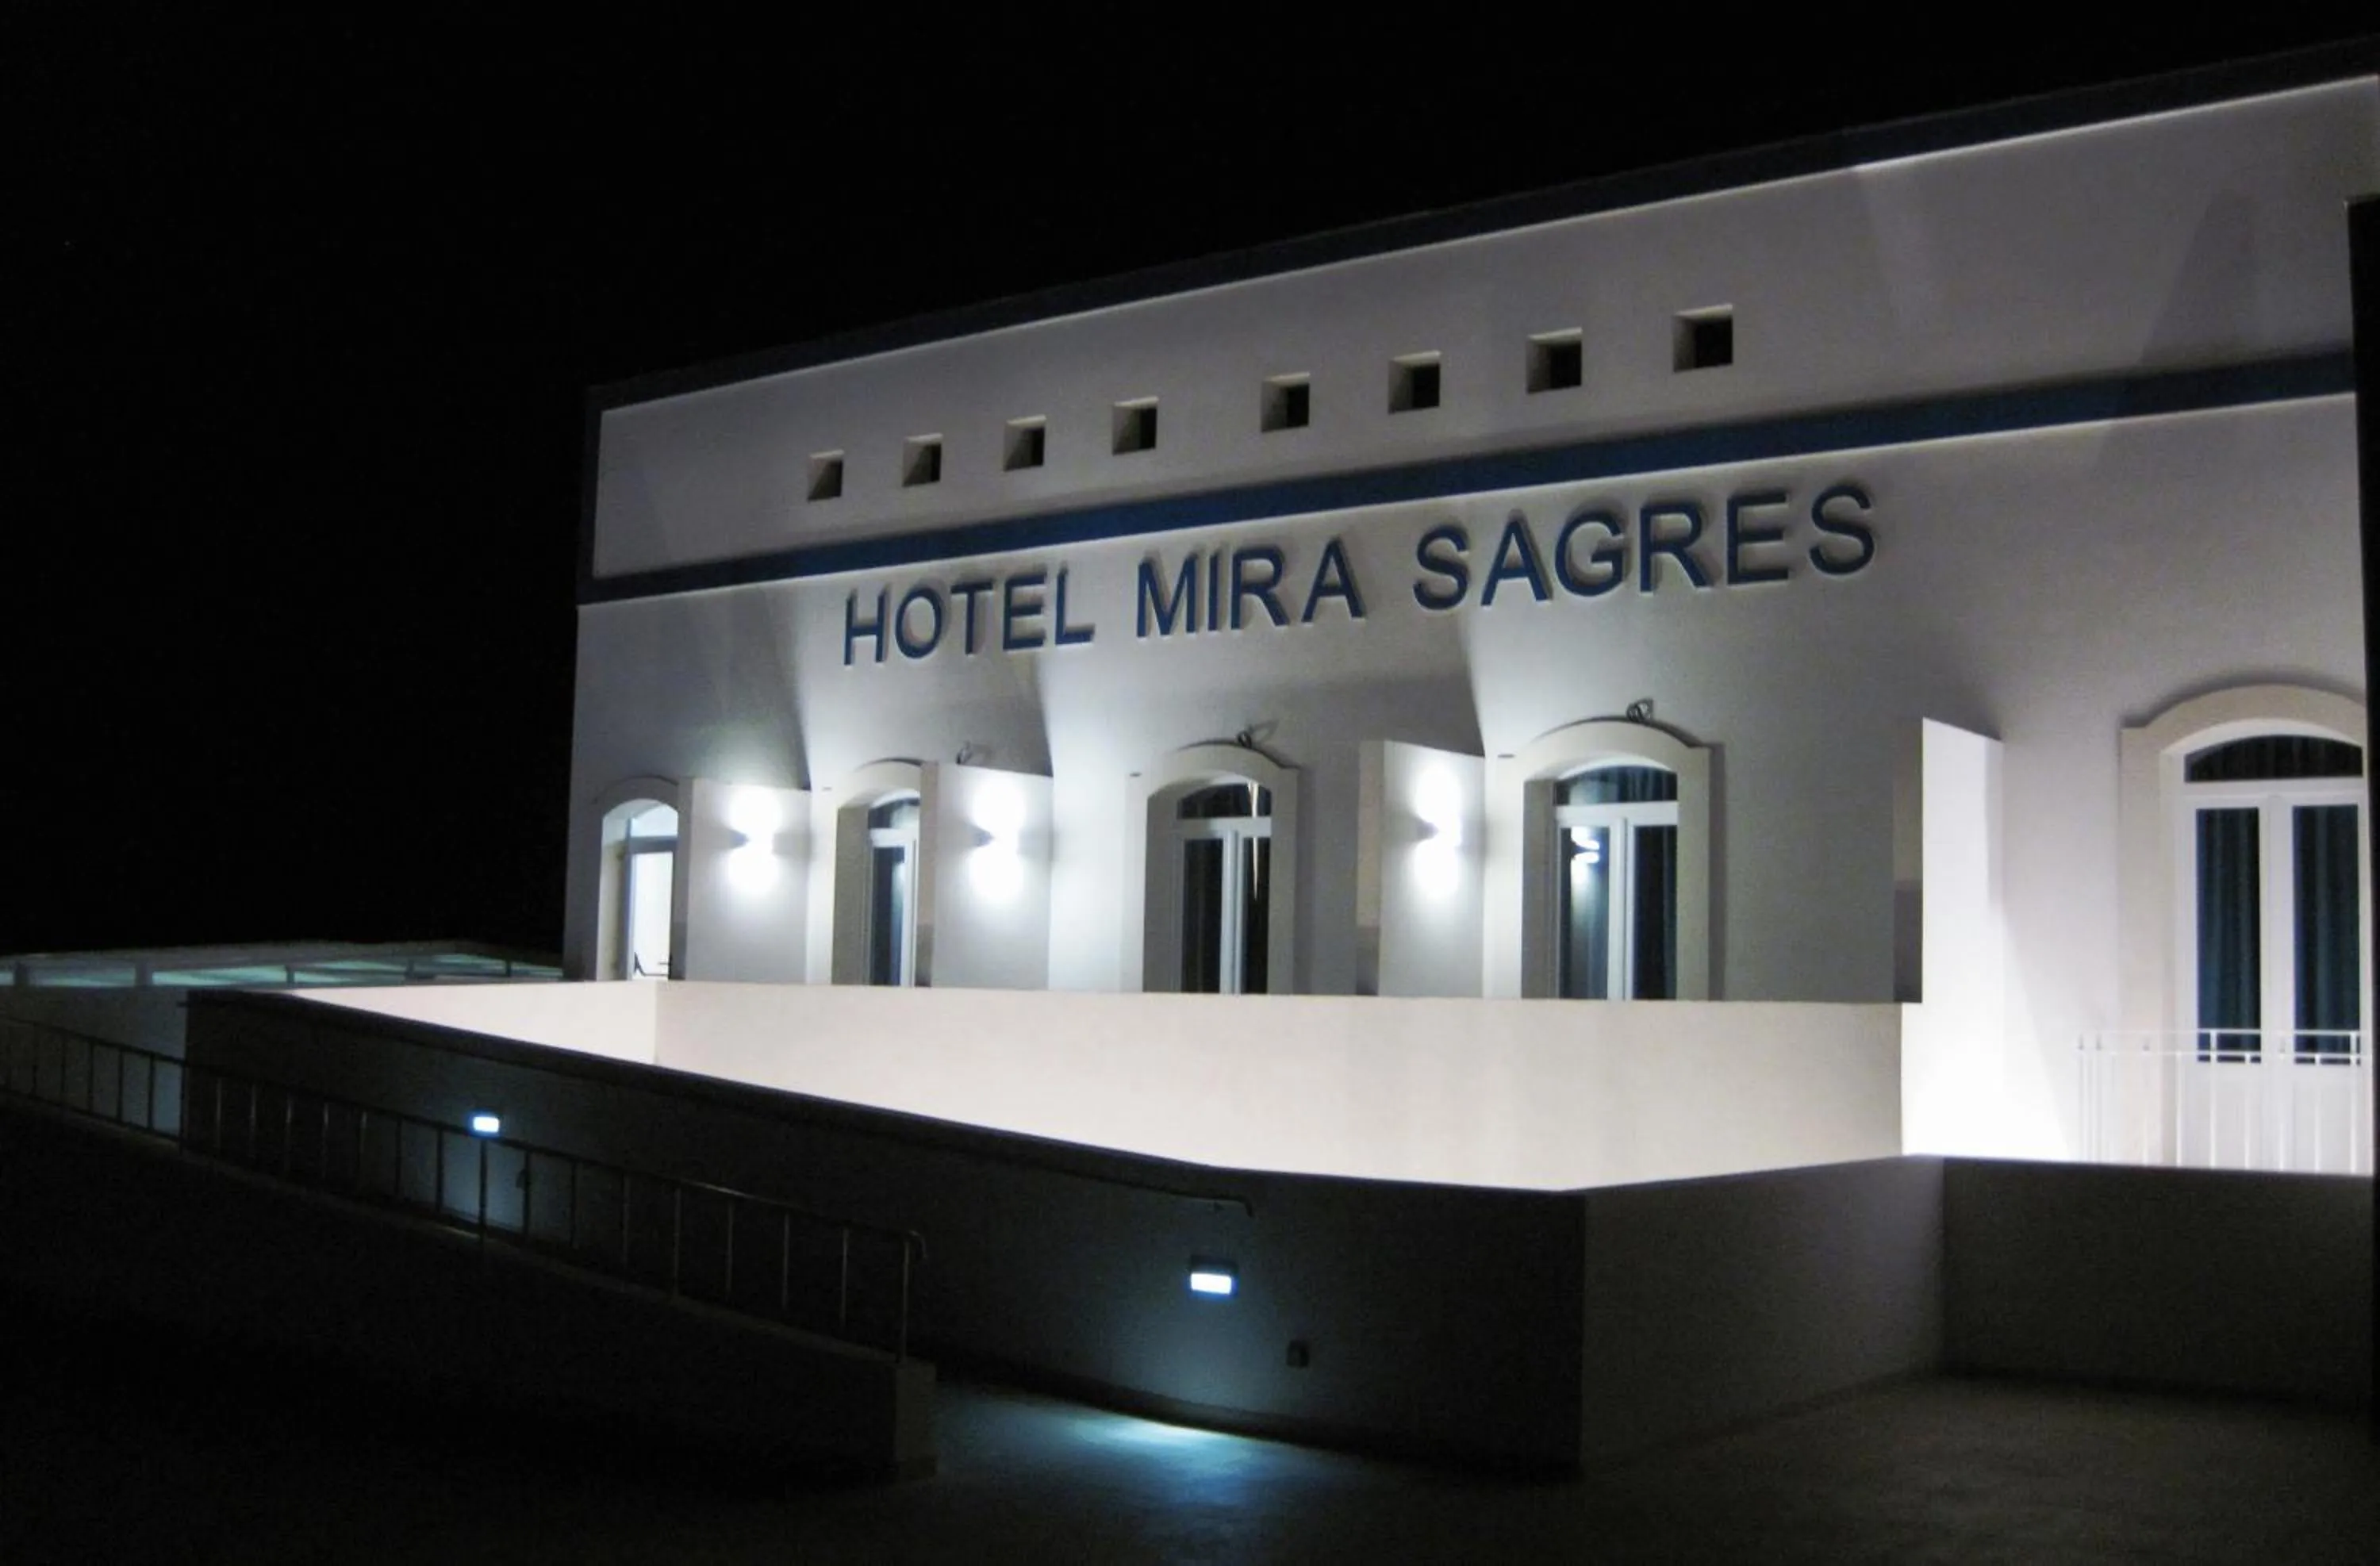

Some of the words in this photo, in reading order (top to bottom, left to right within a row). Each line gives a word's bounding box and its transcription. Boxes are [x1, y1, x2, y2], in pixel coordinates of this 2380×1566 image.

[843, 567, 1096, 666] HOTEL
[1136, 537, 1366, 638] MIRA
[1413, 485, 1875, 611] SAGRES
